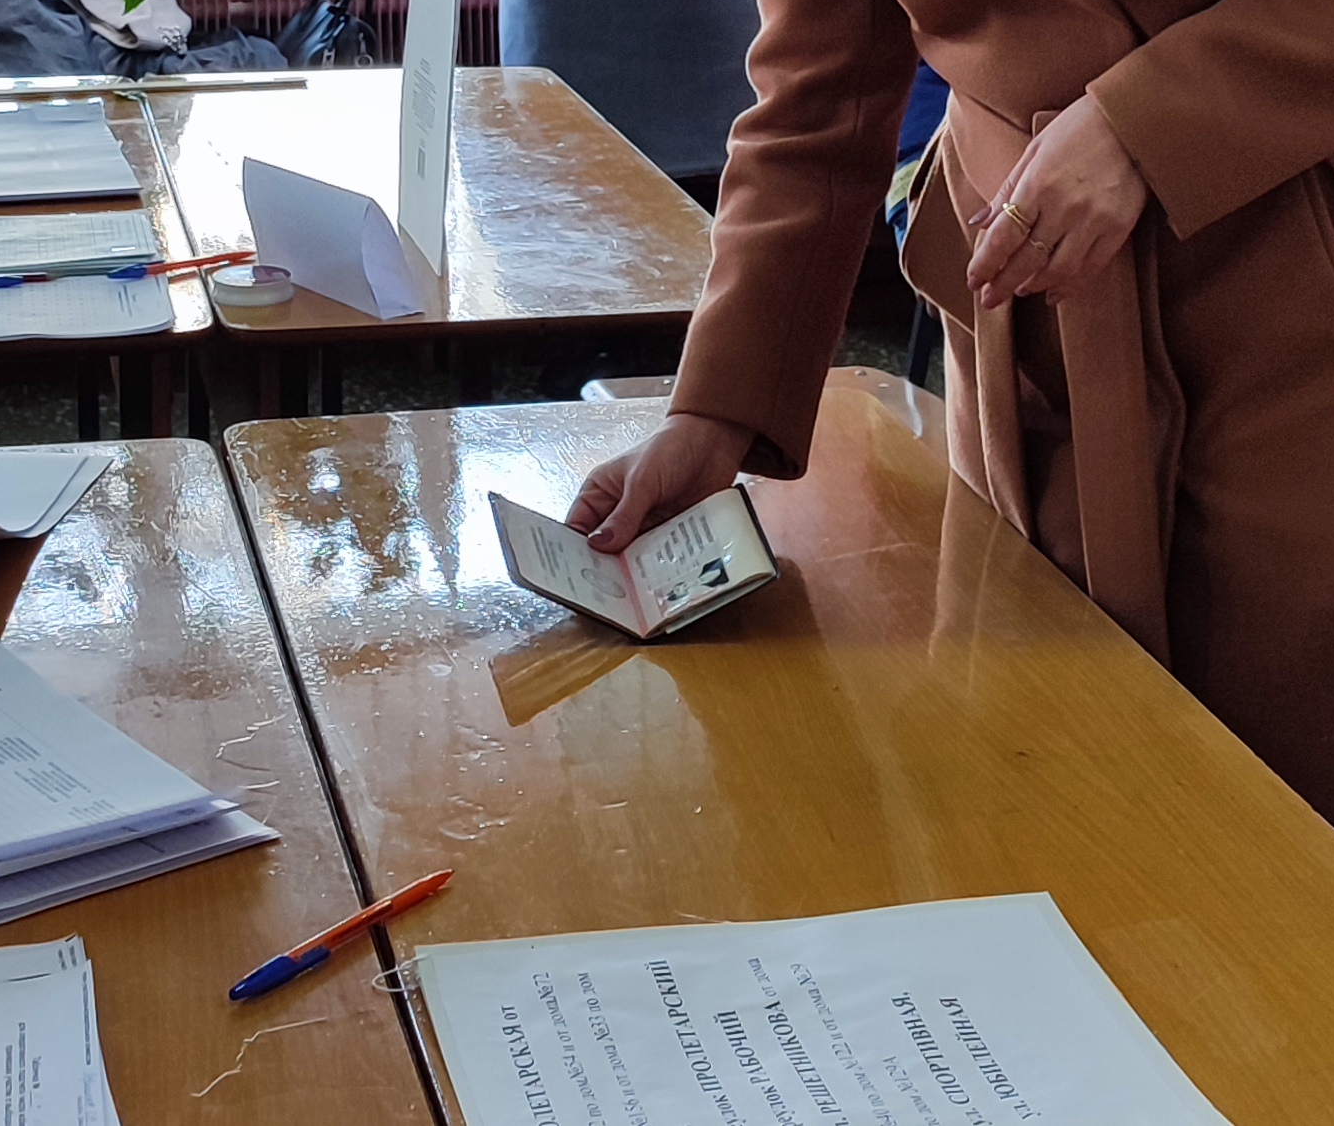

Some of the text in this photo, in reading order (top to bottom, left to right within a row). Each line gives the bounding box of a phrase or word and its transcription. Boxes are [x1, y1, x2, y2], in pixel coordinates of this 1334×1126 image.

[501, 1005, 518, 1021] от
[644, 960, 723, 1093] ПРОЛЕТАРСКИЙ
[712, 1010, 771, 1084] РАБОЧИЙ
[763, 1000, 842, 1114] РЕШЕТНИКОВА
[891, 991, 970, 1105] СПОРТИВНАЯ,
[938, 997, 1019, 1100] ЮБИЛЕЙНАЯ
